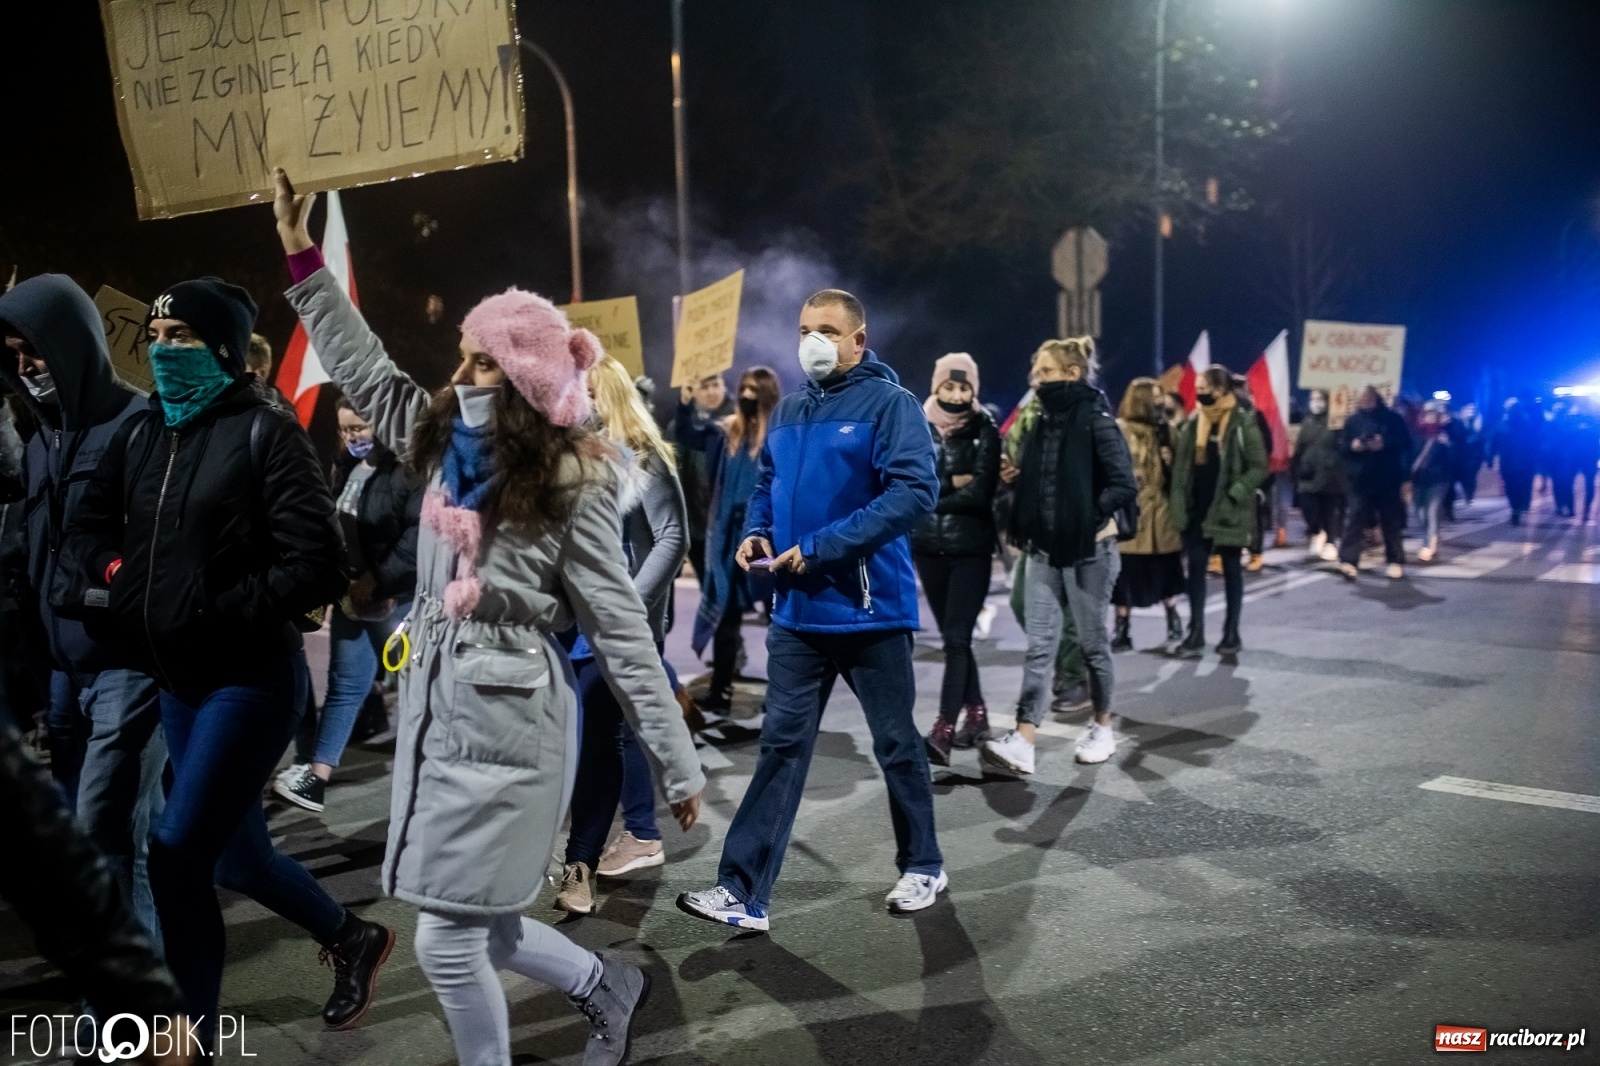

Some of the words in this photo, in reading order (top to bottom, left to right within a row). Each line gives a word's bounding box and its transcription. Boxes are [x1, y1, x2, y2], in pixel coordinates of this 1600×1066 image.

[134, 75, 180, 111] NIE
[187, 44, 333, 102] ZGINEŁA
[355, 21, 444, 73] KIEDY
[192, 107, 272, 178] MY
[105, 307, 150, 365] STR
